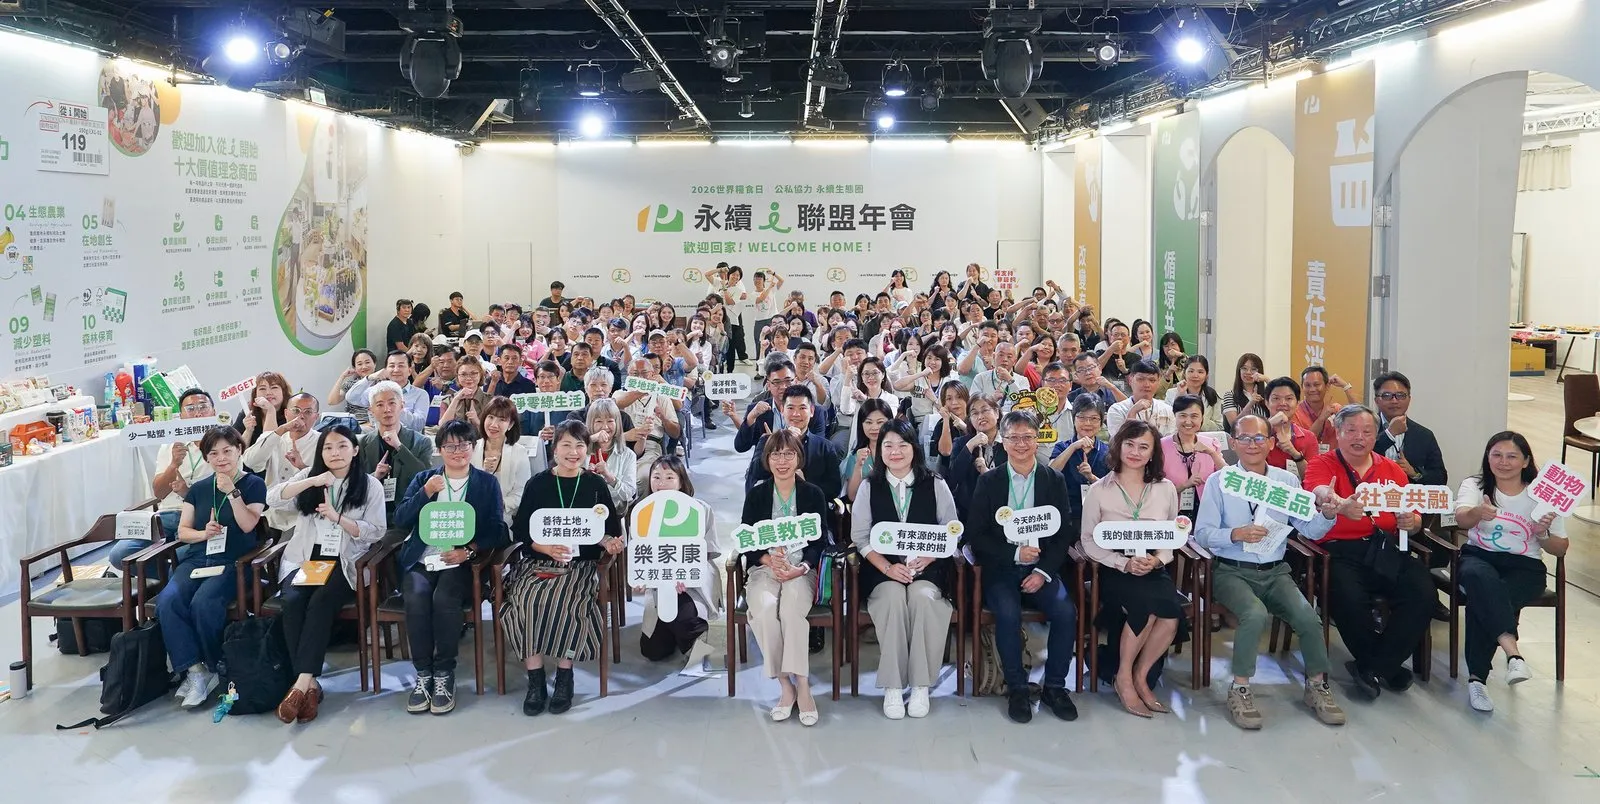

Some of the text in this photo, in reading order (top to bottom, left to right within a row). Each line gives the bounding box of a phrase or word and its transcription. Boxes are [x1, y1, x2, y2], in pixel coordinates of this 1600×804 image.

[74, 108, 87, 119] 開始
[62, 133, 86, 151] 119
[172, 130, 227, 158] 歡迎加入從
[240, 140, 258, 160] 開始
[174, 156, 258, 182] 十大價值理念商品
[692, 185, 864, 194] 2026世界糧食日 公私協力 永續生態圈
[4, 204, 26, 220] 04
[29, 206, 65, 218] 生態農業
[694, 204, 752, 232] 永續
[798, 204, 916, 232] 聯盟年會
[82, 214, 98, 230] 05
[82, 235, 112, 246] 在地創生
[748, 242, 816, 252] WELCOME
[9, 316, 30, 334] 09
[82, 314, 96, 330] 10
[14, 333, 51, 350] 減少塑料
[82, 330, 112, 346] 森林保育
[220, 379, 254, 400] 永續GET
[513, 394, 582, 410] 淨零綠生活
[1543, 464, 1586, 496] 動物
[1224, 470, 1311, 516] 有機產品
[1360, 487, 1449, 510] 社會共融
[1533, 481, 1574, 512] 福利
[430, 520, 464, 529] 家在共融
[1012, 512, 1052, 526] 今天的永續
[542, 527, 591, 538] 好菜自然來
[736, 517, 818, 548] 食農教育
[897, 530, 948, 542] 有來源的紙
[1017, 524, 1048, 534] 從我開始
[1102, 530, 1174, 540] 我的健康無添加
[634, 543, 700, 564] 樂家康
[896, 541, 946, 553] 有未來的樹
[634, 569, 700, 580] 文教基金會
